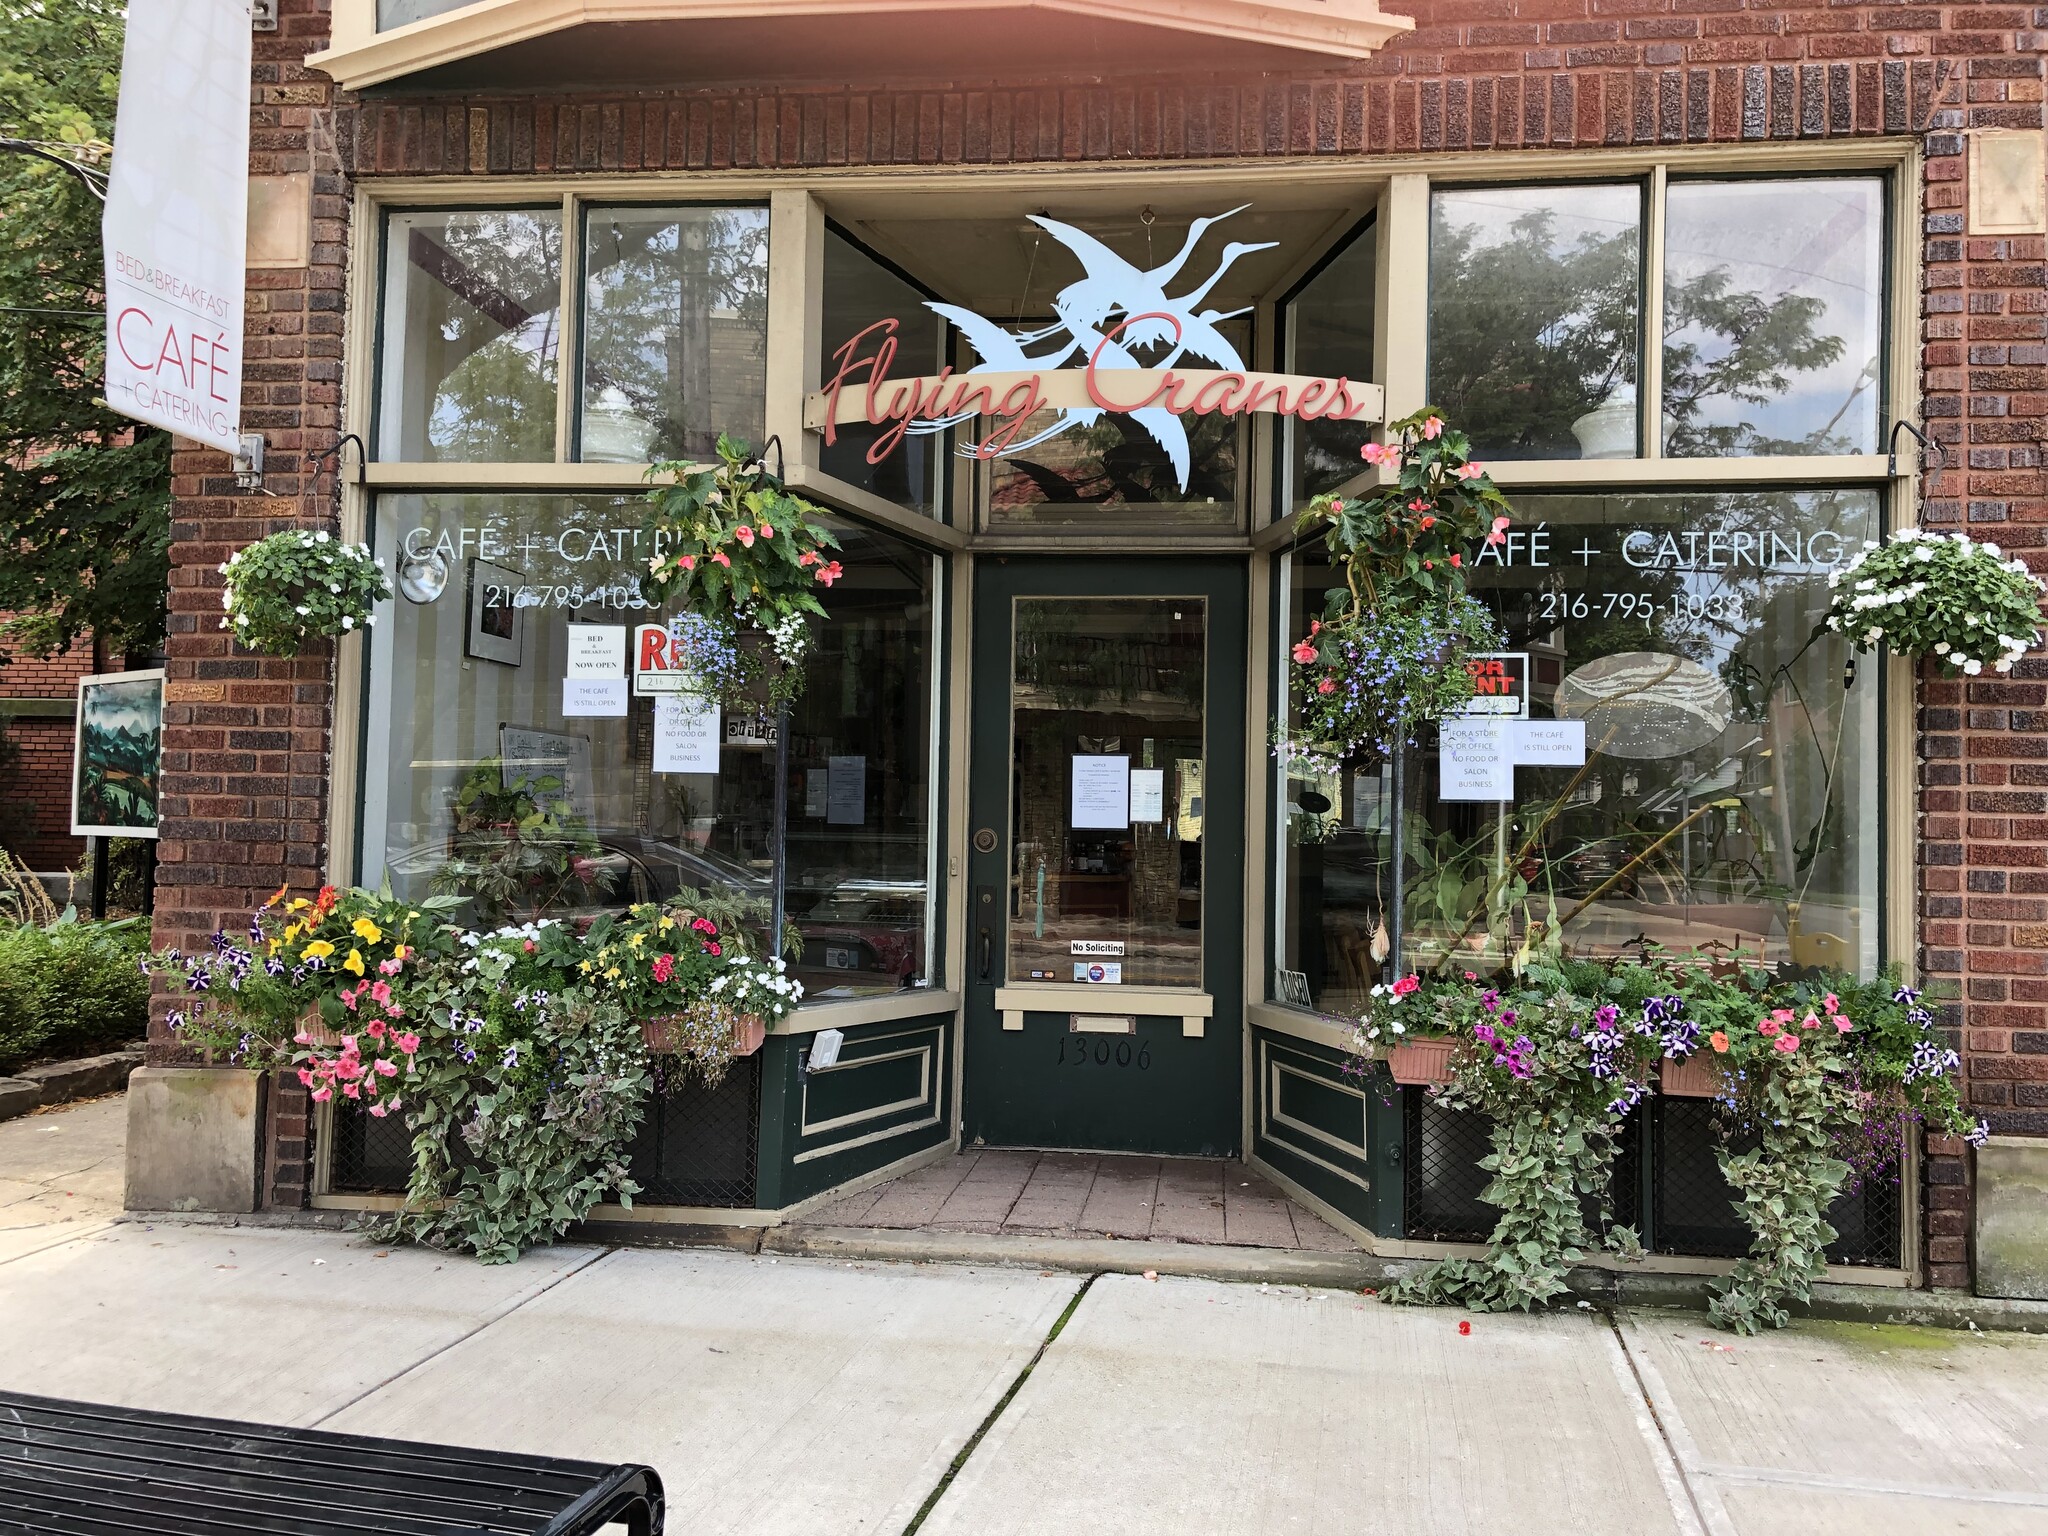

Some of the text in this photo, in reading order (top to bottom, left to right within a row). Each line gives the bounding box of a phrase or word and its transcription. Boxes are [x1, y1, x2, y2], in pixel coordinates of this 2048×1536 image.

[117, 307, 229, 403] CAFÉ
[821, 312, 1365, 465] Flying Cranes
[405, 520, 497, 561] CAFÉ
[514, 533, 541, 559] +
[1469, 521, 1844, 568] AFÉ + CATERING
[1540, 593, 1745, 620] 216-795-1033
[1464, 660, 1504, 676] OR
[1473, 676, 1515, 694] NT
[1072, 943, 1123, 955] No Soliciting
[1057, 1037, 1151, 1070] 13006
